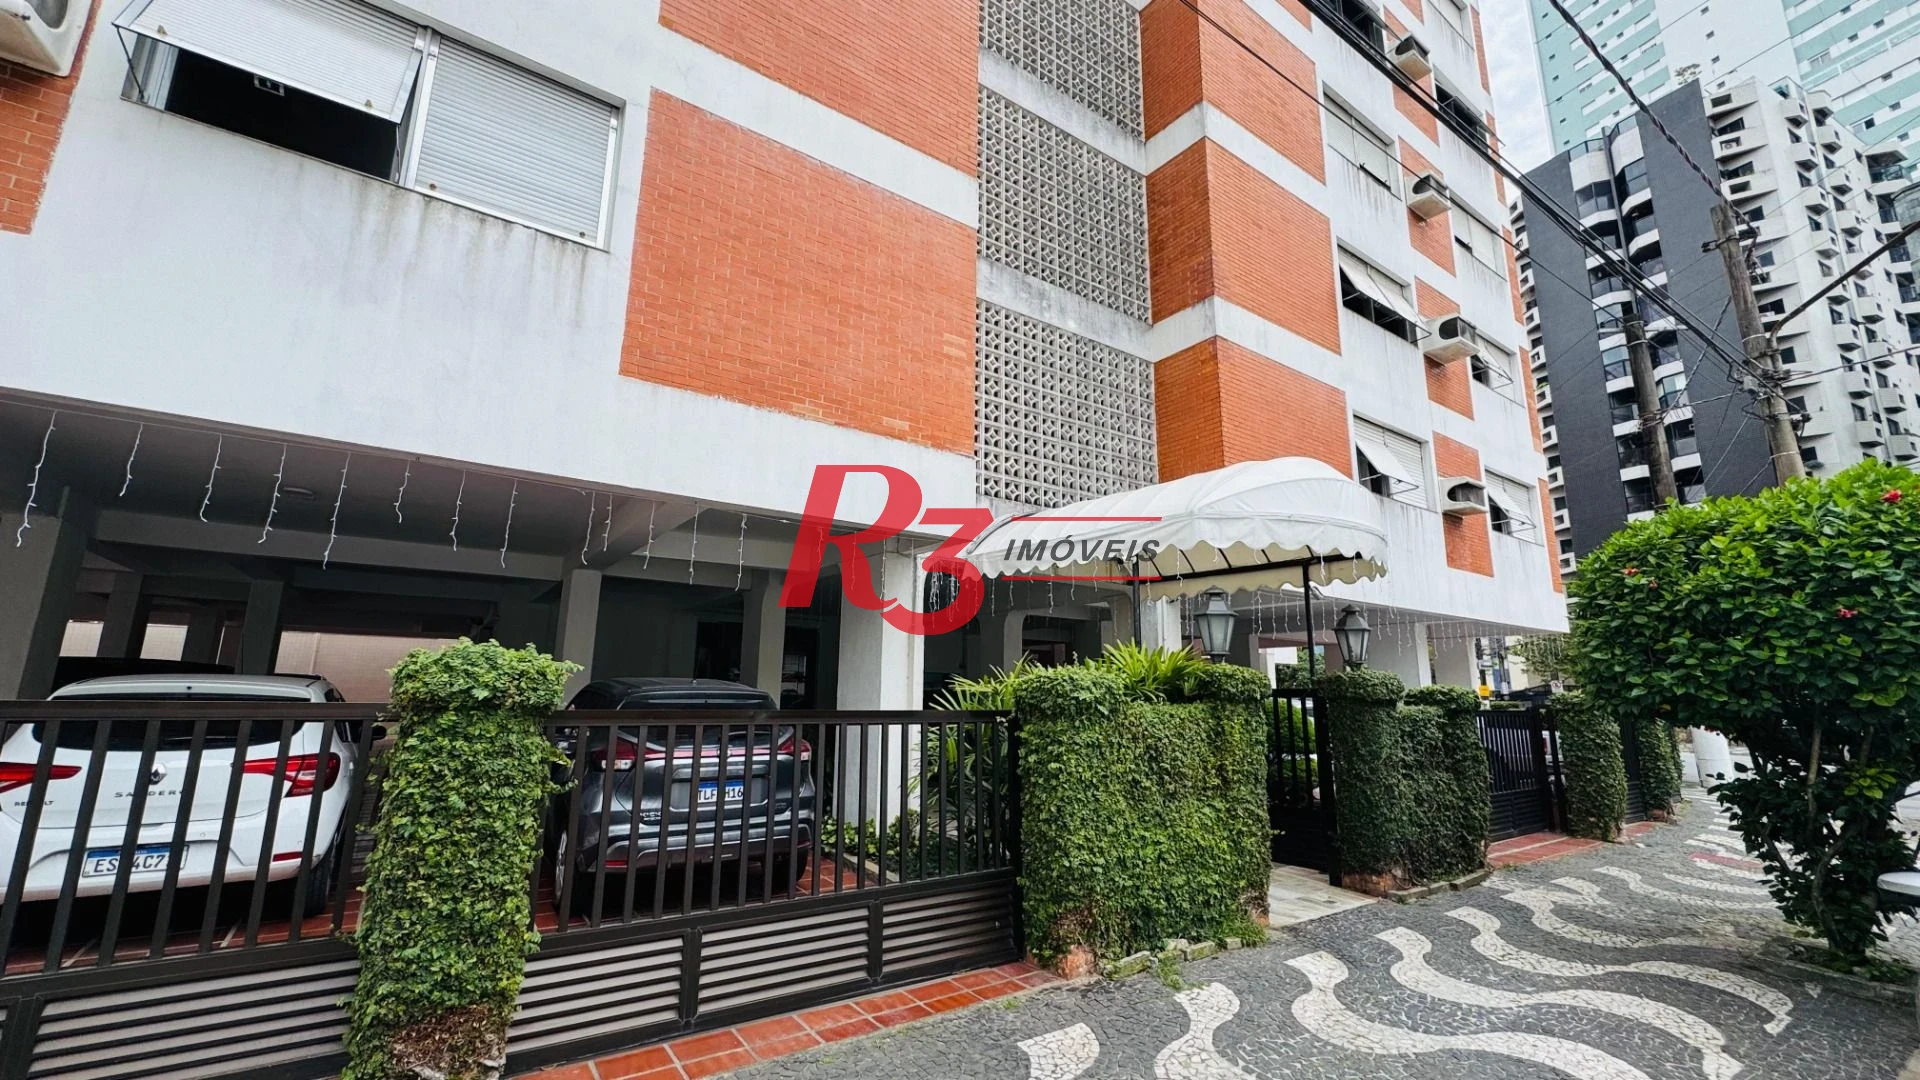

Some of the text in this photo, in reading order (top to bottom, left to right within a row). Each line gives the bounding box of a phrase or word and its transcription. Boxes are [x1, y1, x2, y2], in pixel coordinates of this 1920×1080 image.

[114, 790, 184, 798] SADER
[698, 787, 743, 801] TLFH16
[93, 854, 170, 873] ES4C7
